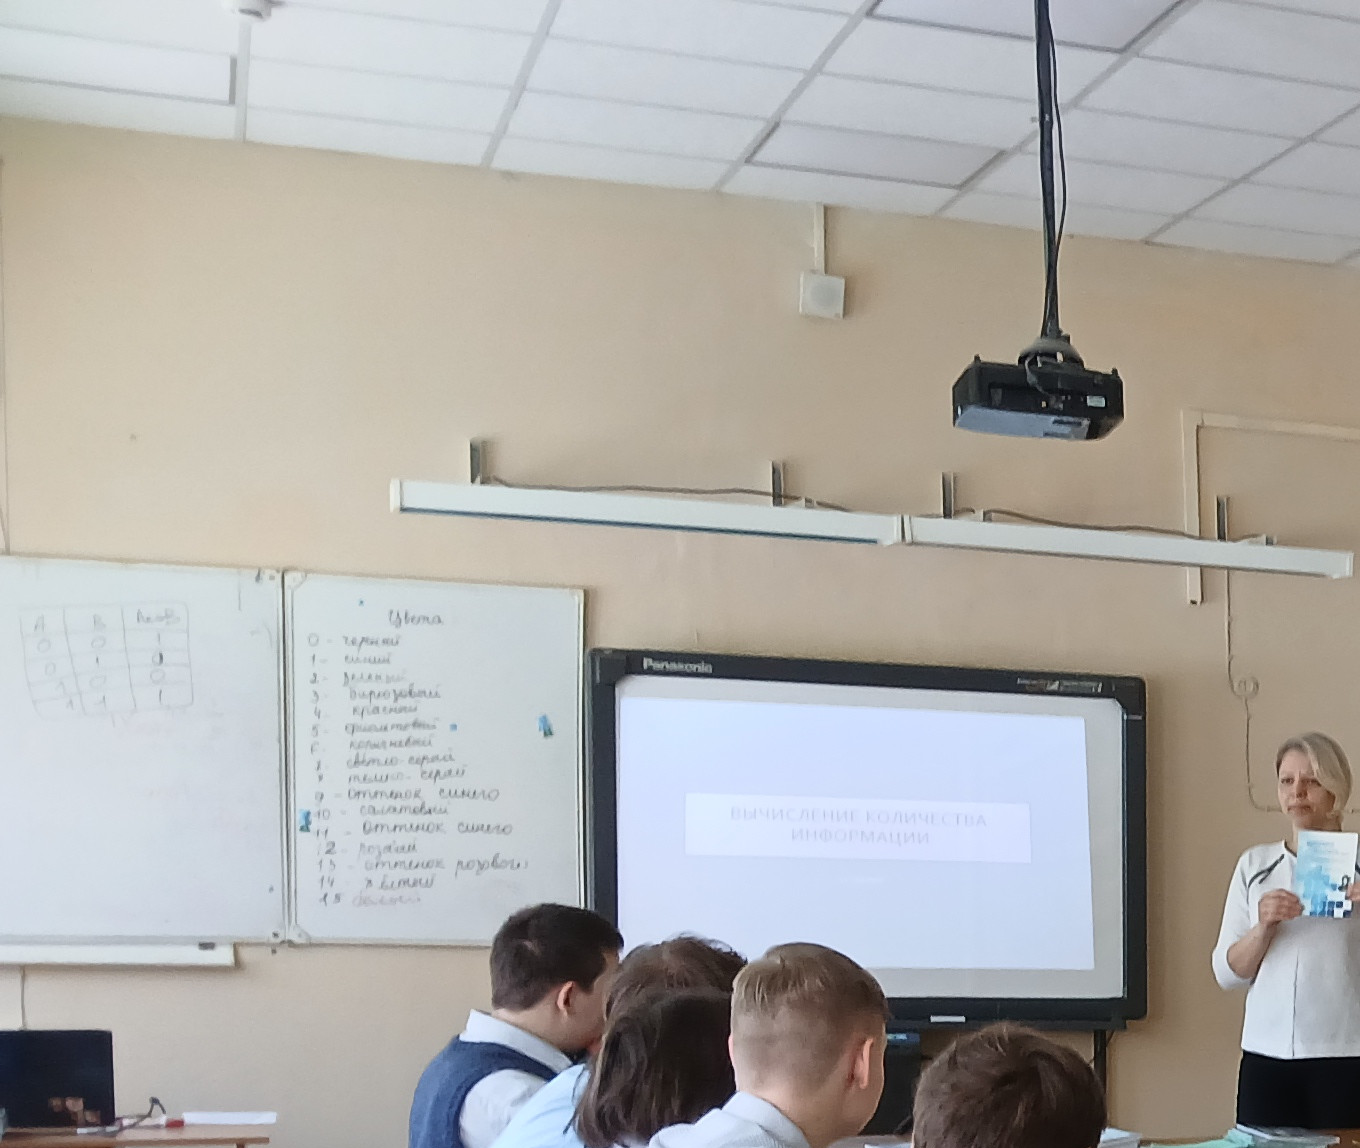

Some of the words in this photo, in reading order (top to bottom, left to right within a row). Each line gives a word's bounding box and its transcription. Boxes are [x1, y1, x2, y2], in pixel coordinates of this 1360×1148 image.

[643, 656, 713, 674] Panasonic
[730, 805, 860, 825] ВЫЧИСЛЕНИЕ
[865, 808, 988, 828] КОЛИЧЕСТВА
[790, 826, 931, 847] ИНФОРМАЦИИ
